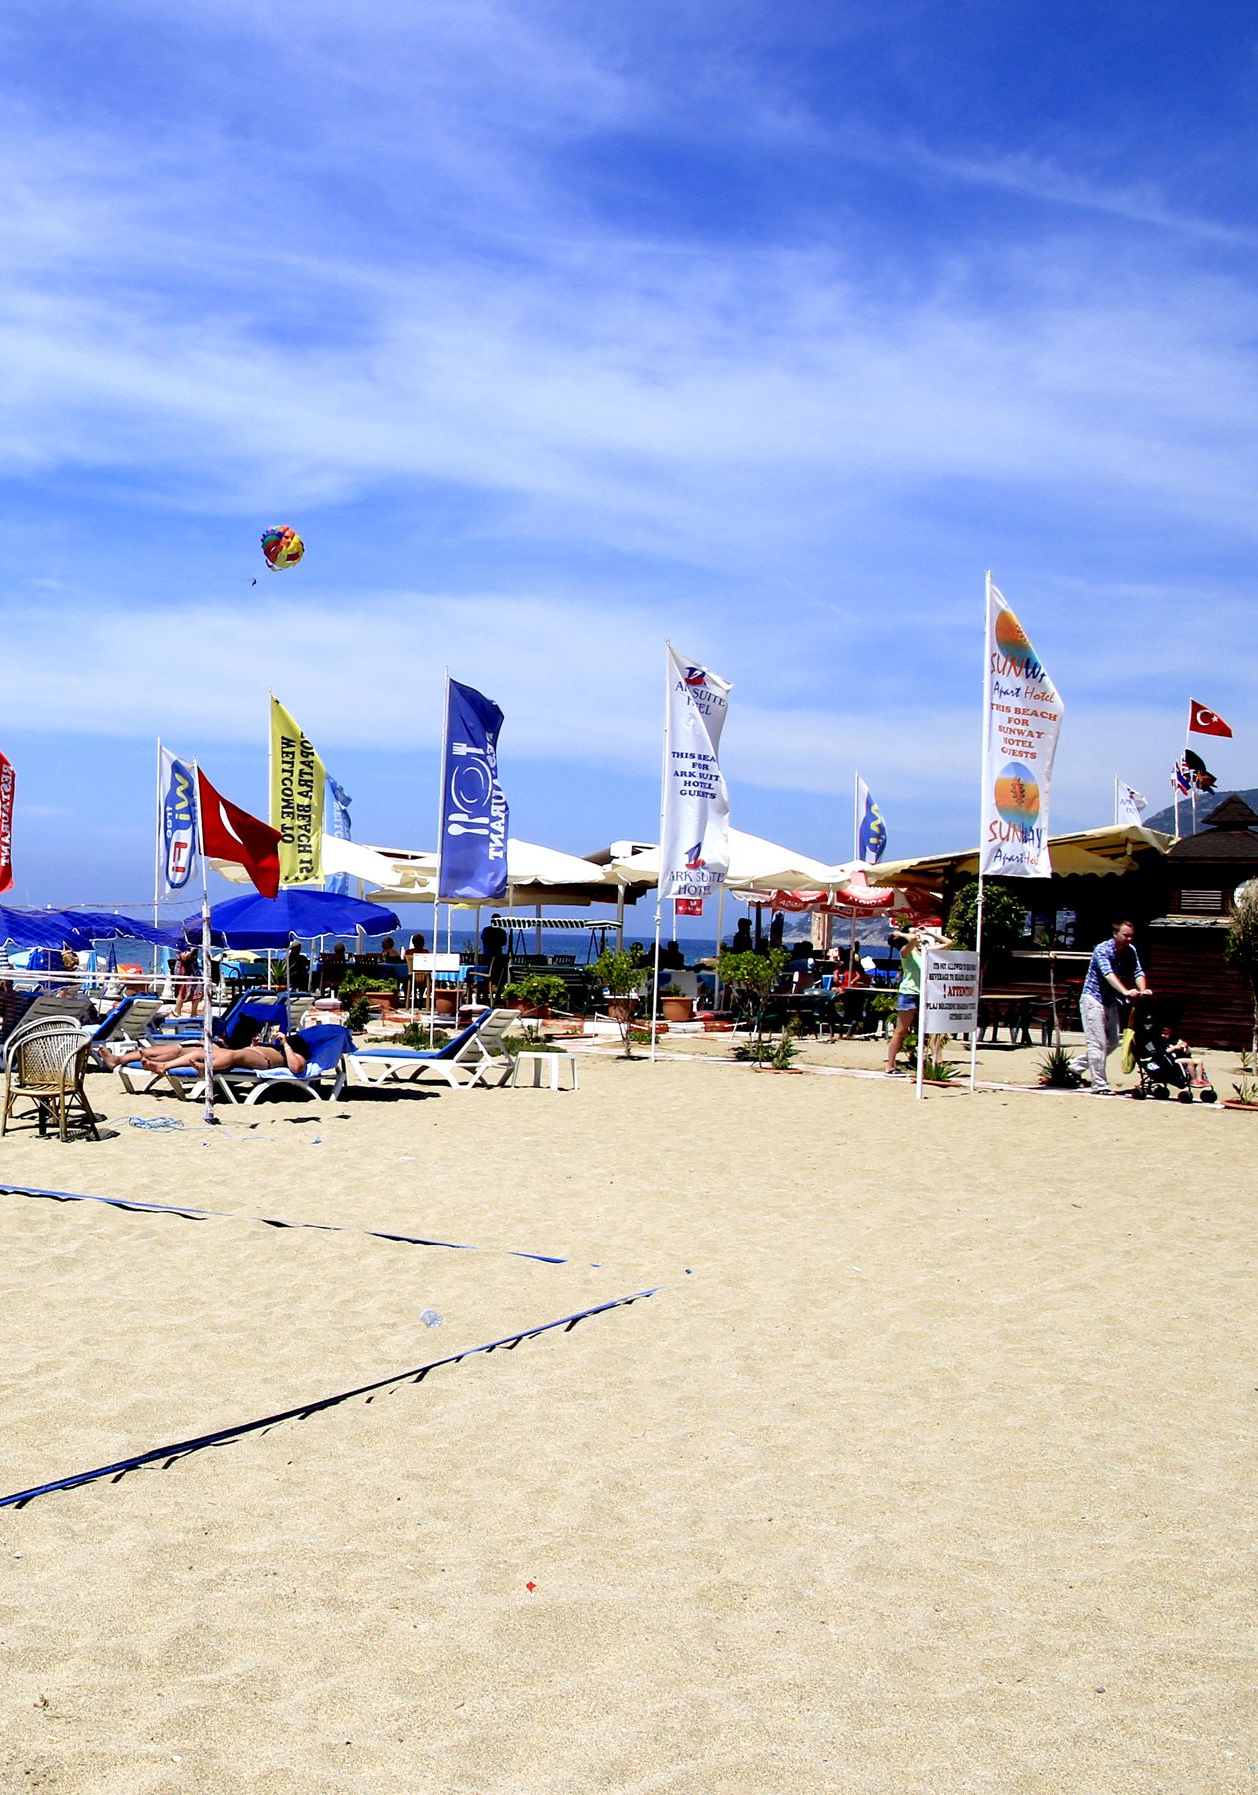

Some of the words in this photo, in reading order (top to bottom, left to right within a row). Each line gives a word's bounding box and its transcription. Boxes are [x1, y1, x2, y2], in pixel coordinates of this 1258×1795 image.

[994, 681, 1021, 698] Apart
[1024, 686, 1054, 703] Hotel
[991, 703, 1011, 713] THIS
[1014, 708, 1058, 721] BEACH
[1008, 716, 1029, 726] FOR
[998, 725, 1044, 738] SUNWAY
[692, 762, 709, 770] FOR
[684, 780, 714, 790] HOTEL
[994, 848, 1023, 866] Apart
[669, 871, 692, 882] ARK
[696, 872, 724, 882] SUITE
